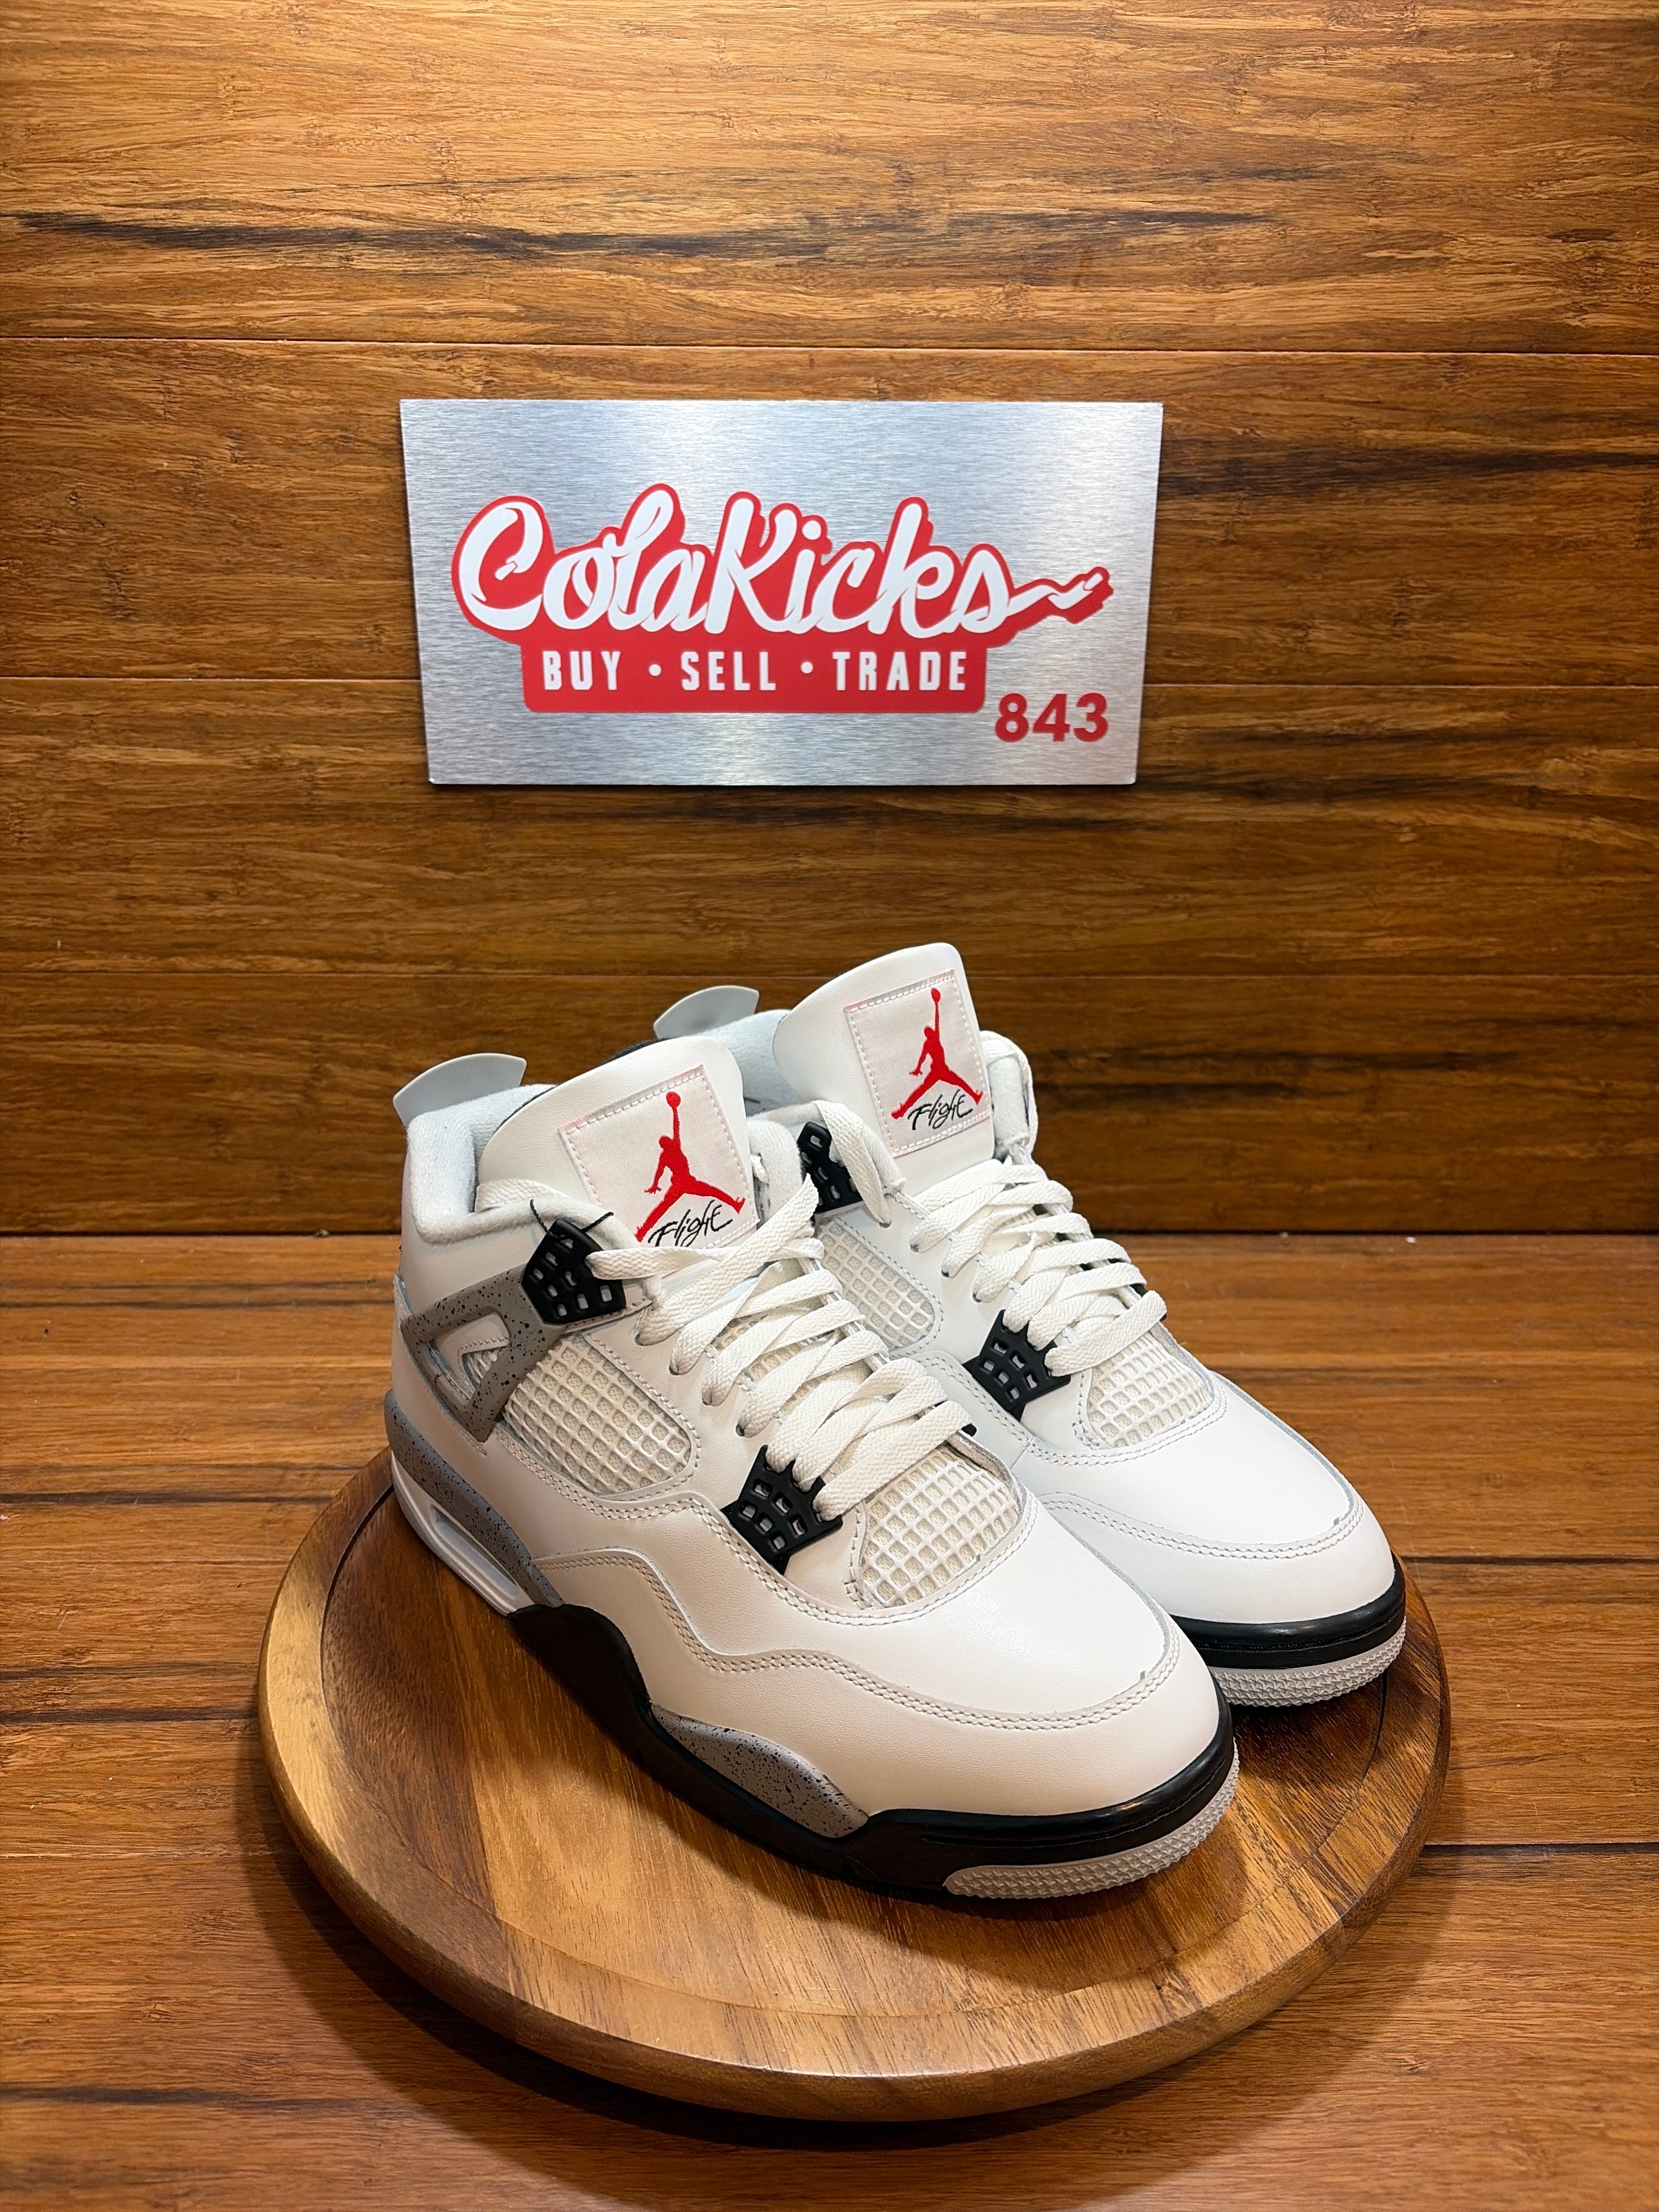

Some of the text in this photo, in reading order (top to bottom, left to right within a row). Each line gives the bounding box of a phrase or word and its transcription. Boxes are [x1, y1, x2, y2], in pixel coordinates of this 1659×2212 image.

[542, 650, 967, 691] BUY SELL TRADE
[994, 692, 1109, 743] 843
[907, 1088, 974, 1131] Flight
[647, 1199, 733, 1247] Flight
